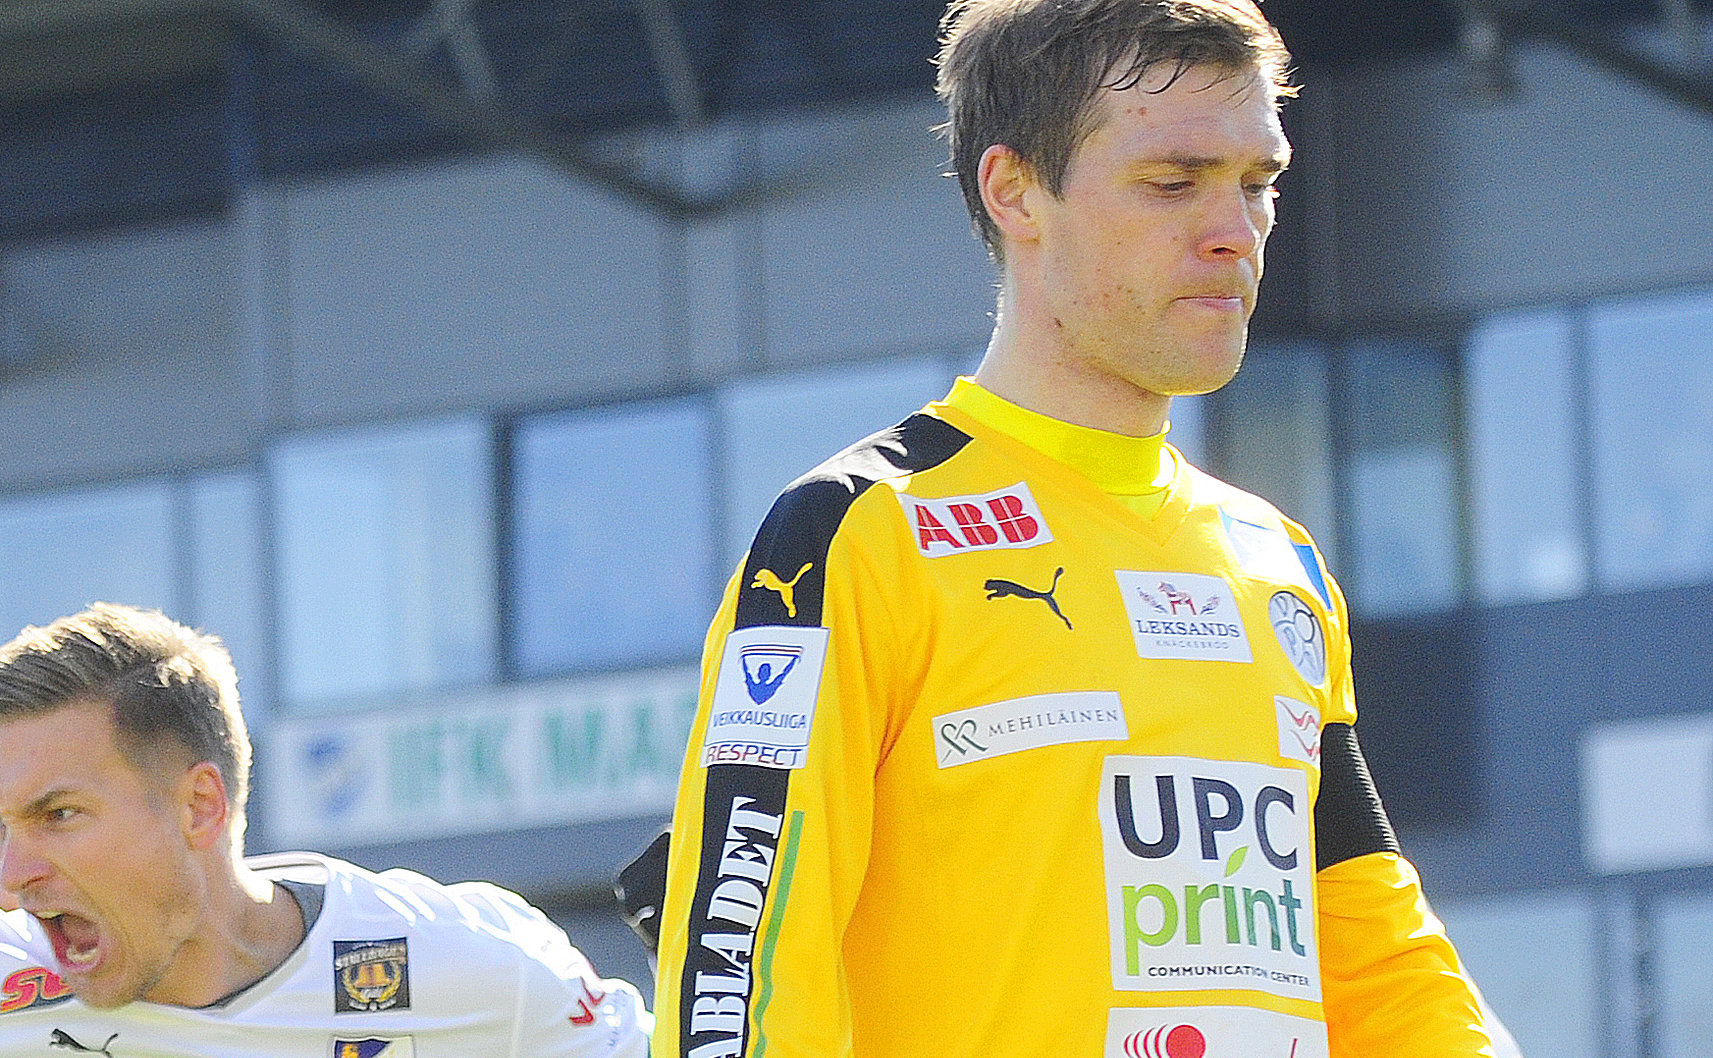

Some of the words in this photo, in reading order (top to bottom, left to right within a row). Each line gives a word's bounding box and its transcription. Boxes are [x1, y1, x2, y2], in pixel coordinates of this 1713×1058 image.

[913, 494, 1040, 551] ABB
[1136, 619, 1240, 637] LEKSANDS
[713, 709, 807, 730] VEIKKAUSLIIGA
[988, 706, 1119, 739] MEHILÄINEN
[706, 742, 803, 767] RESPECT
[1113, 774, 1299, 871] UPC
[1124, 846, 1306, 977] print
[1148, 965, 1268, 979] COMMUNICATION
[1270, 971, 1310, 987] CENTER
